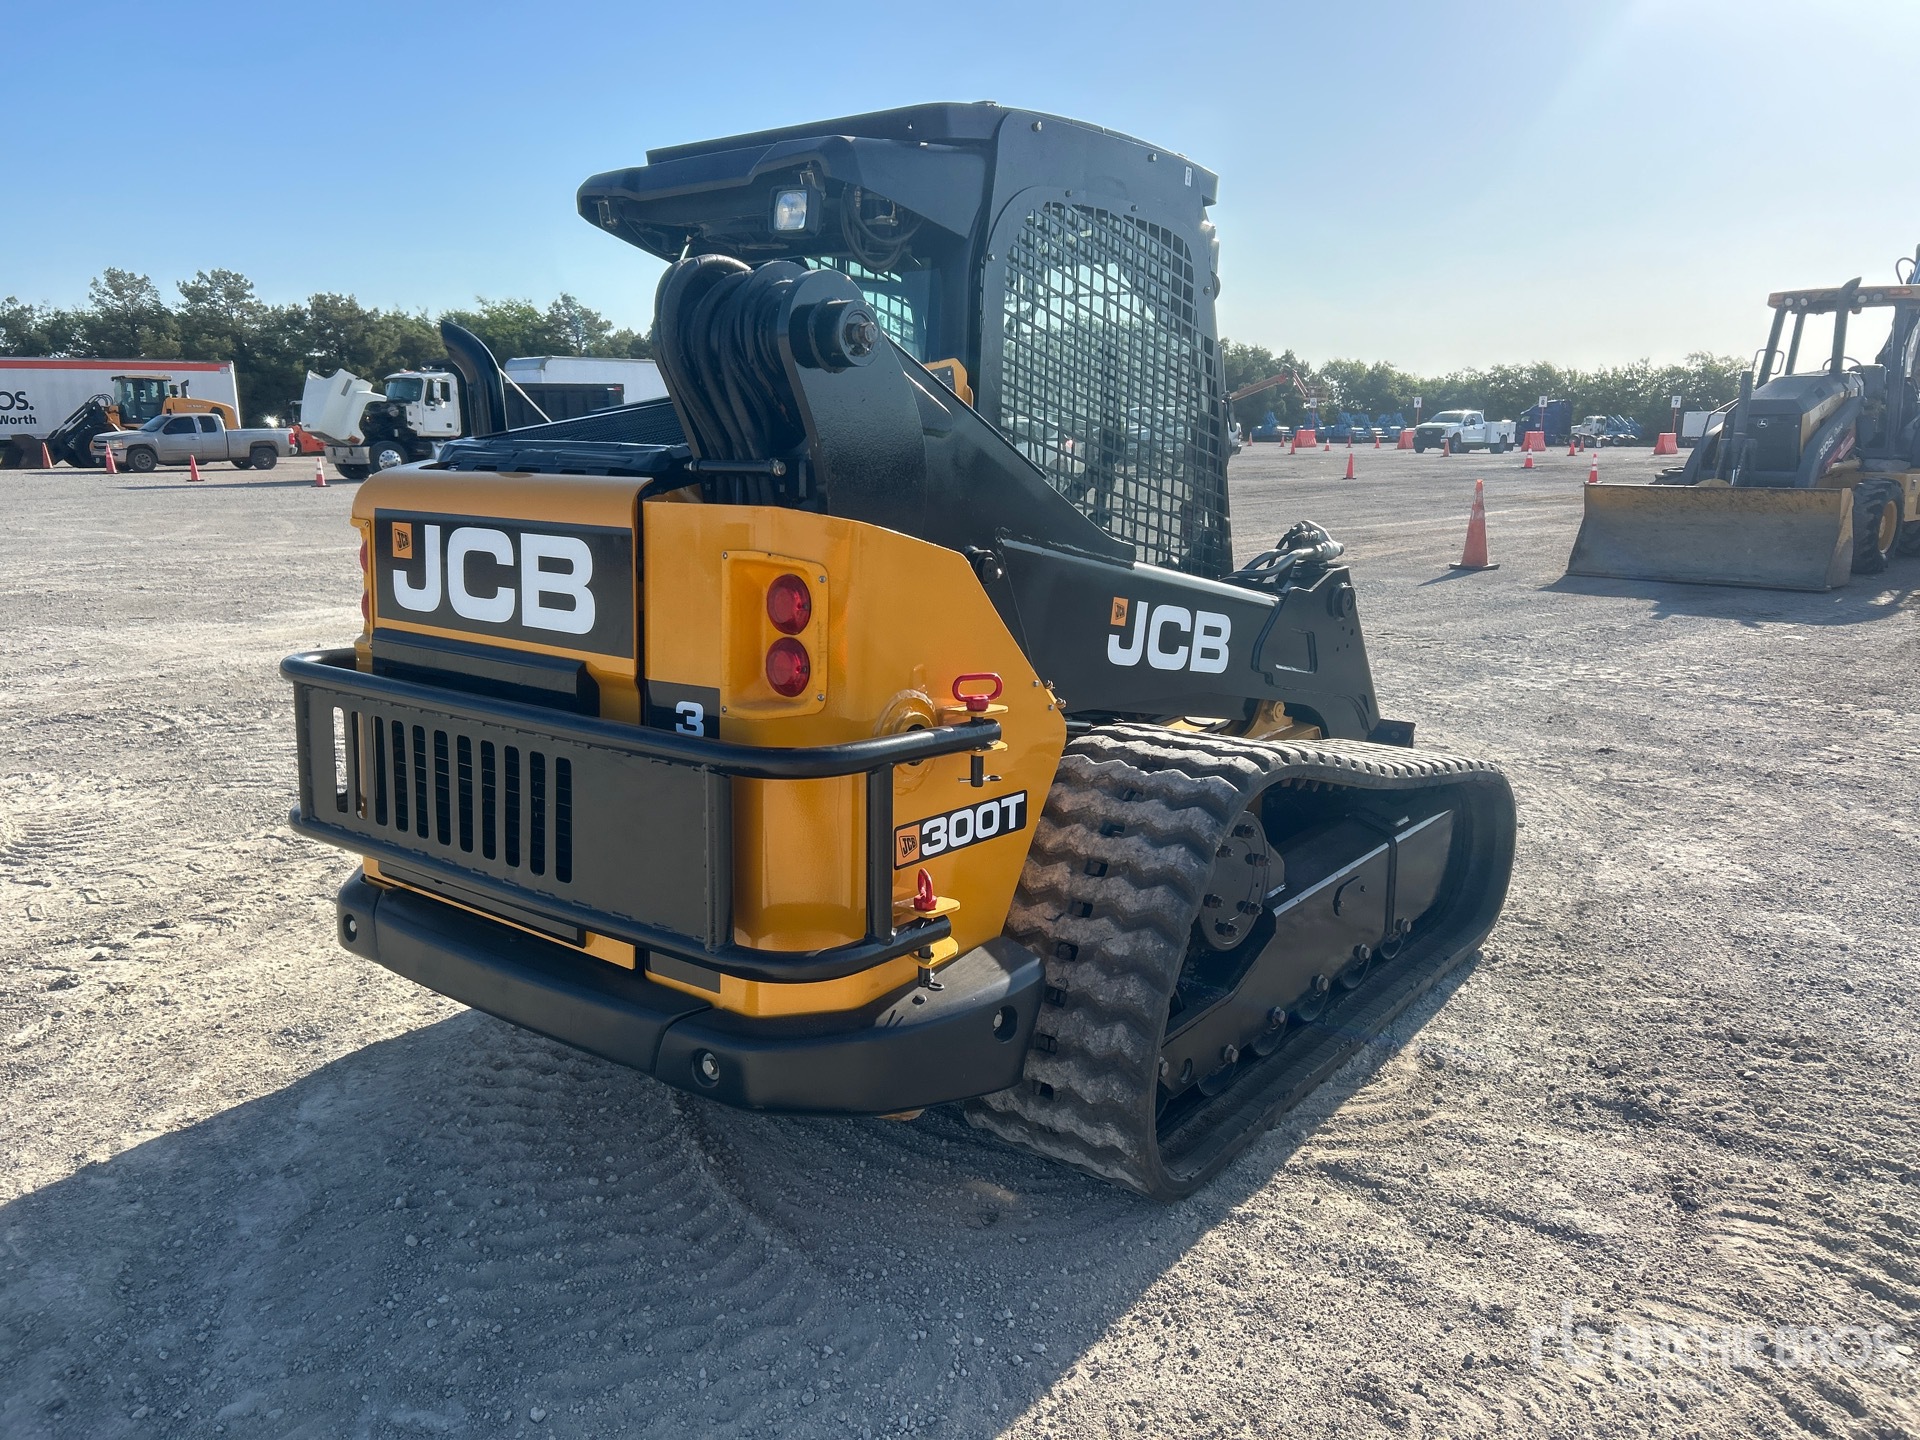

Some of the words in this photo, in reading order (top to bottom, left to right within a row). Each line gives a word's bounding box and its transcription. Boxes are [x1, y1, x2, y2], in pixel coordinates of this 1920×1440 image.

[392, 524, 596, 635] JCB
[1107, 600, 1232, 674] JCB
[675, 701, 705, 738] 3
[901, 836, 917, 857] JCB
[921, 792, 1026, 857] 300T
